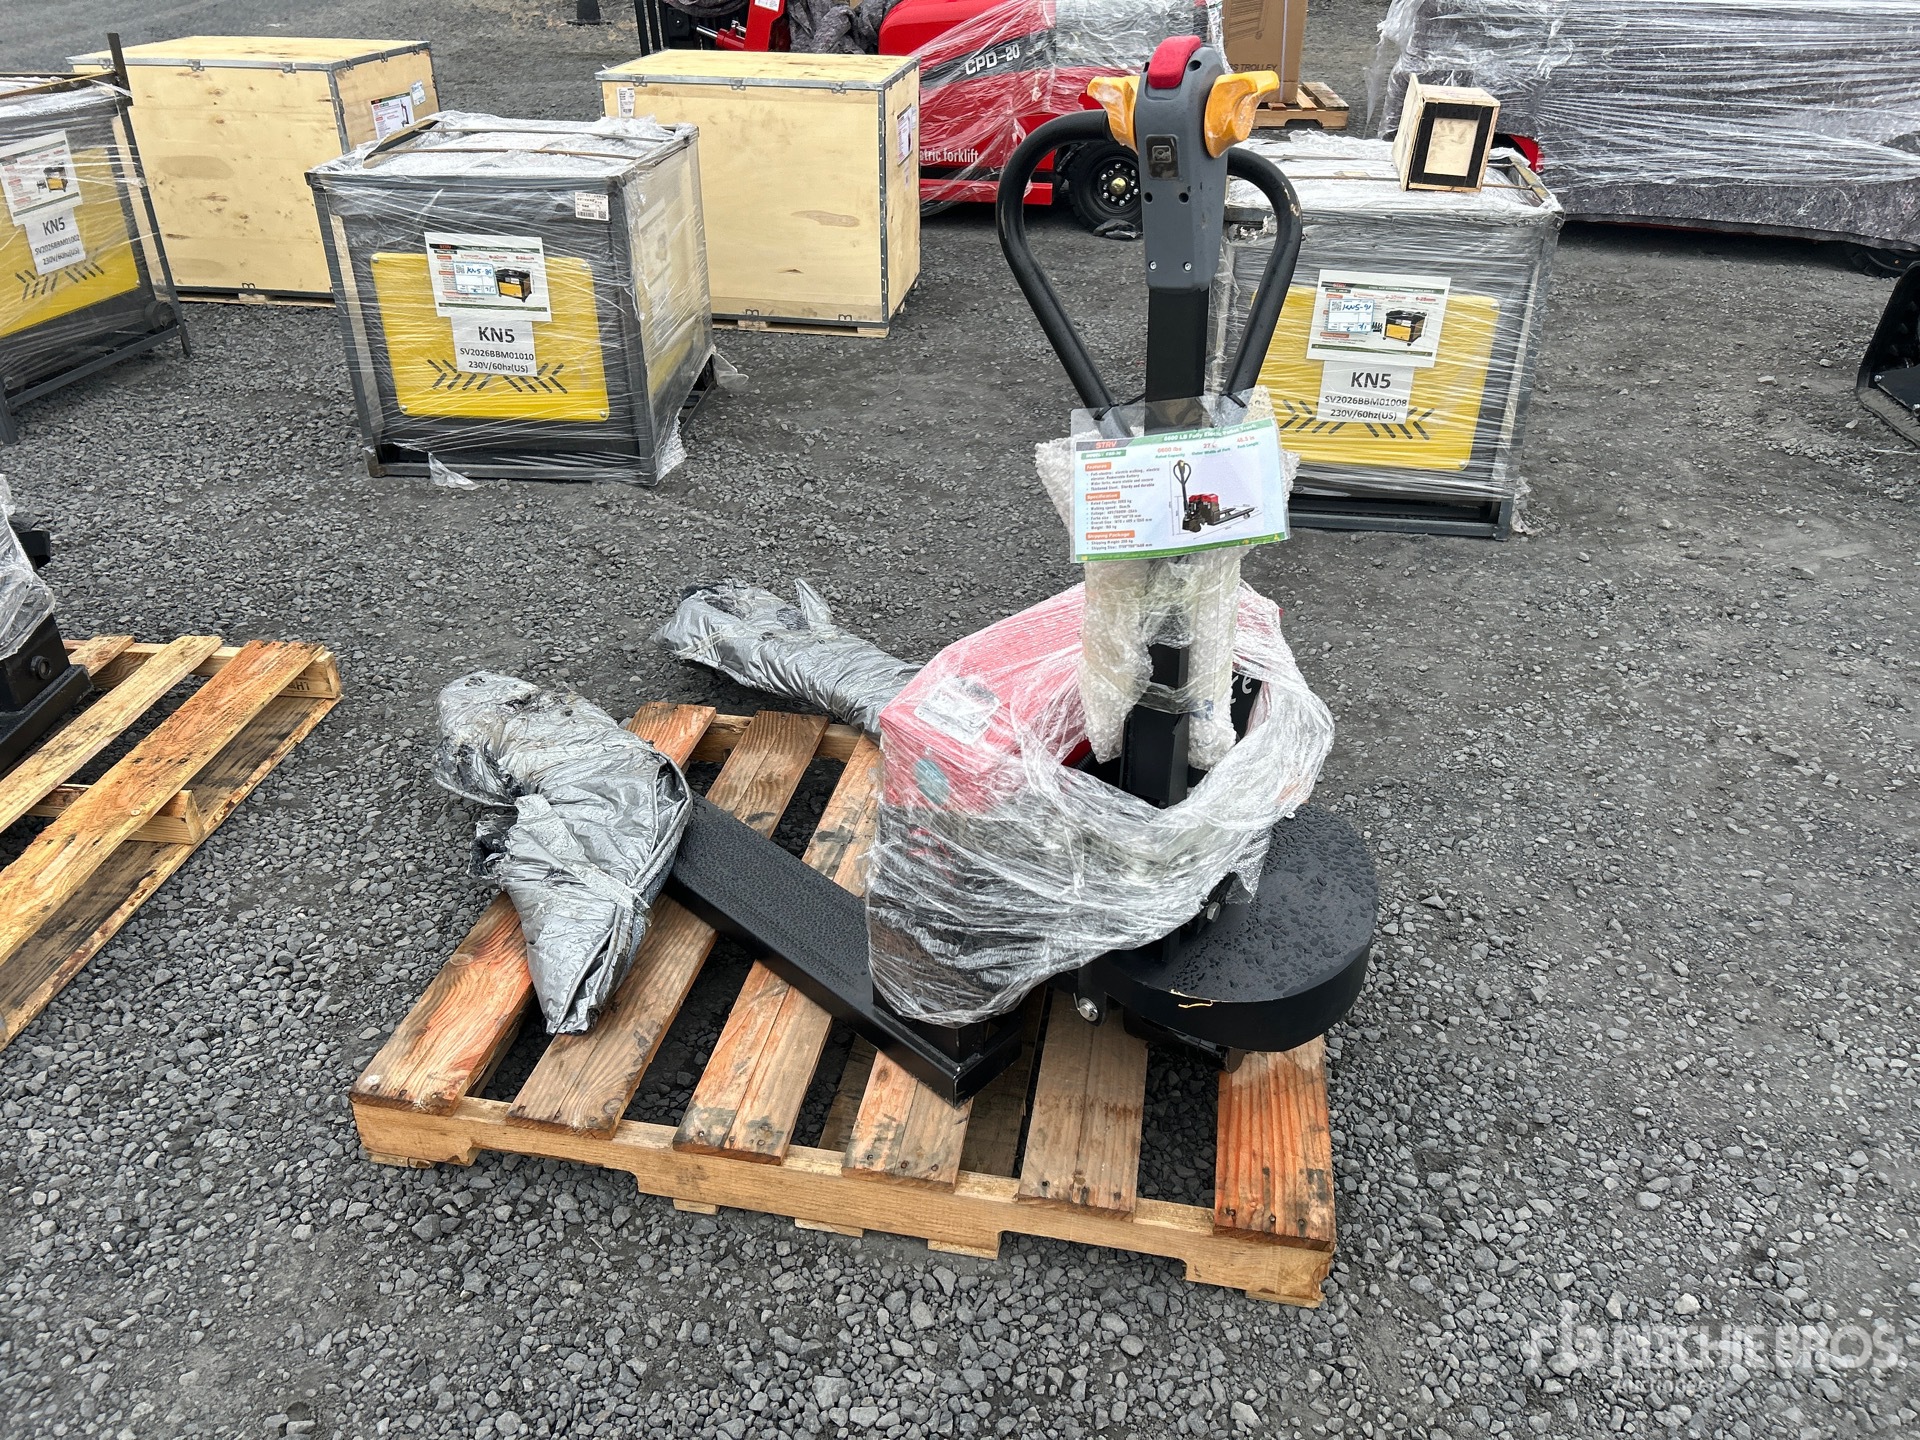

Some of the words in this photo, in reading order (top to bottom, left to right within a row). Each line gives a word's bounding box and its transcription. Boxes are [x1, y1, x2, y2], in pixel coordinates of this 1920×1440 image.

[965, 43, 1020, 75] CPD-20
[943, 148, 978, 162] forklift
[42, 216, 66, 236] KN5
[478, 326, 515, 343] KN5
[460, 348, 534, 360] SV2026BBM01010
[468, 361, 528, 374] 230V/60hz(US)
[1350, 372, 1392, 389] KN5
[1324, 395, 1408, 407] SV2026BBM01008
[1330, 409, 1397, 421] 230V/60hz(US)
[1095, 440, 1117, 449] STRV
